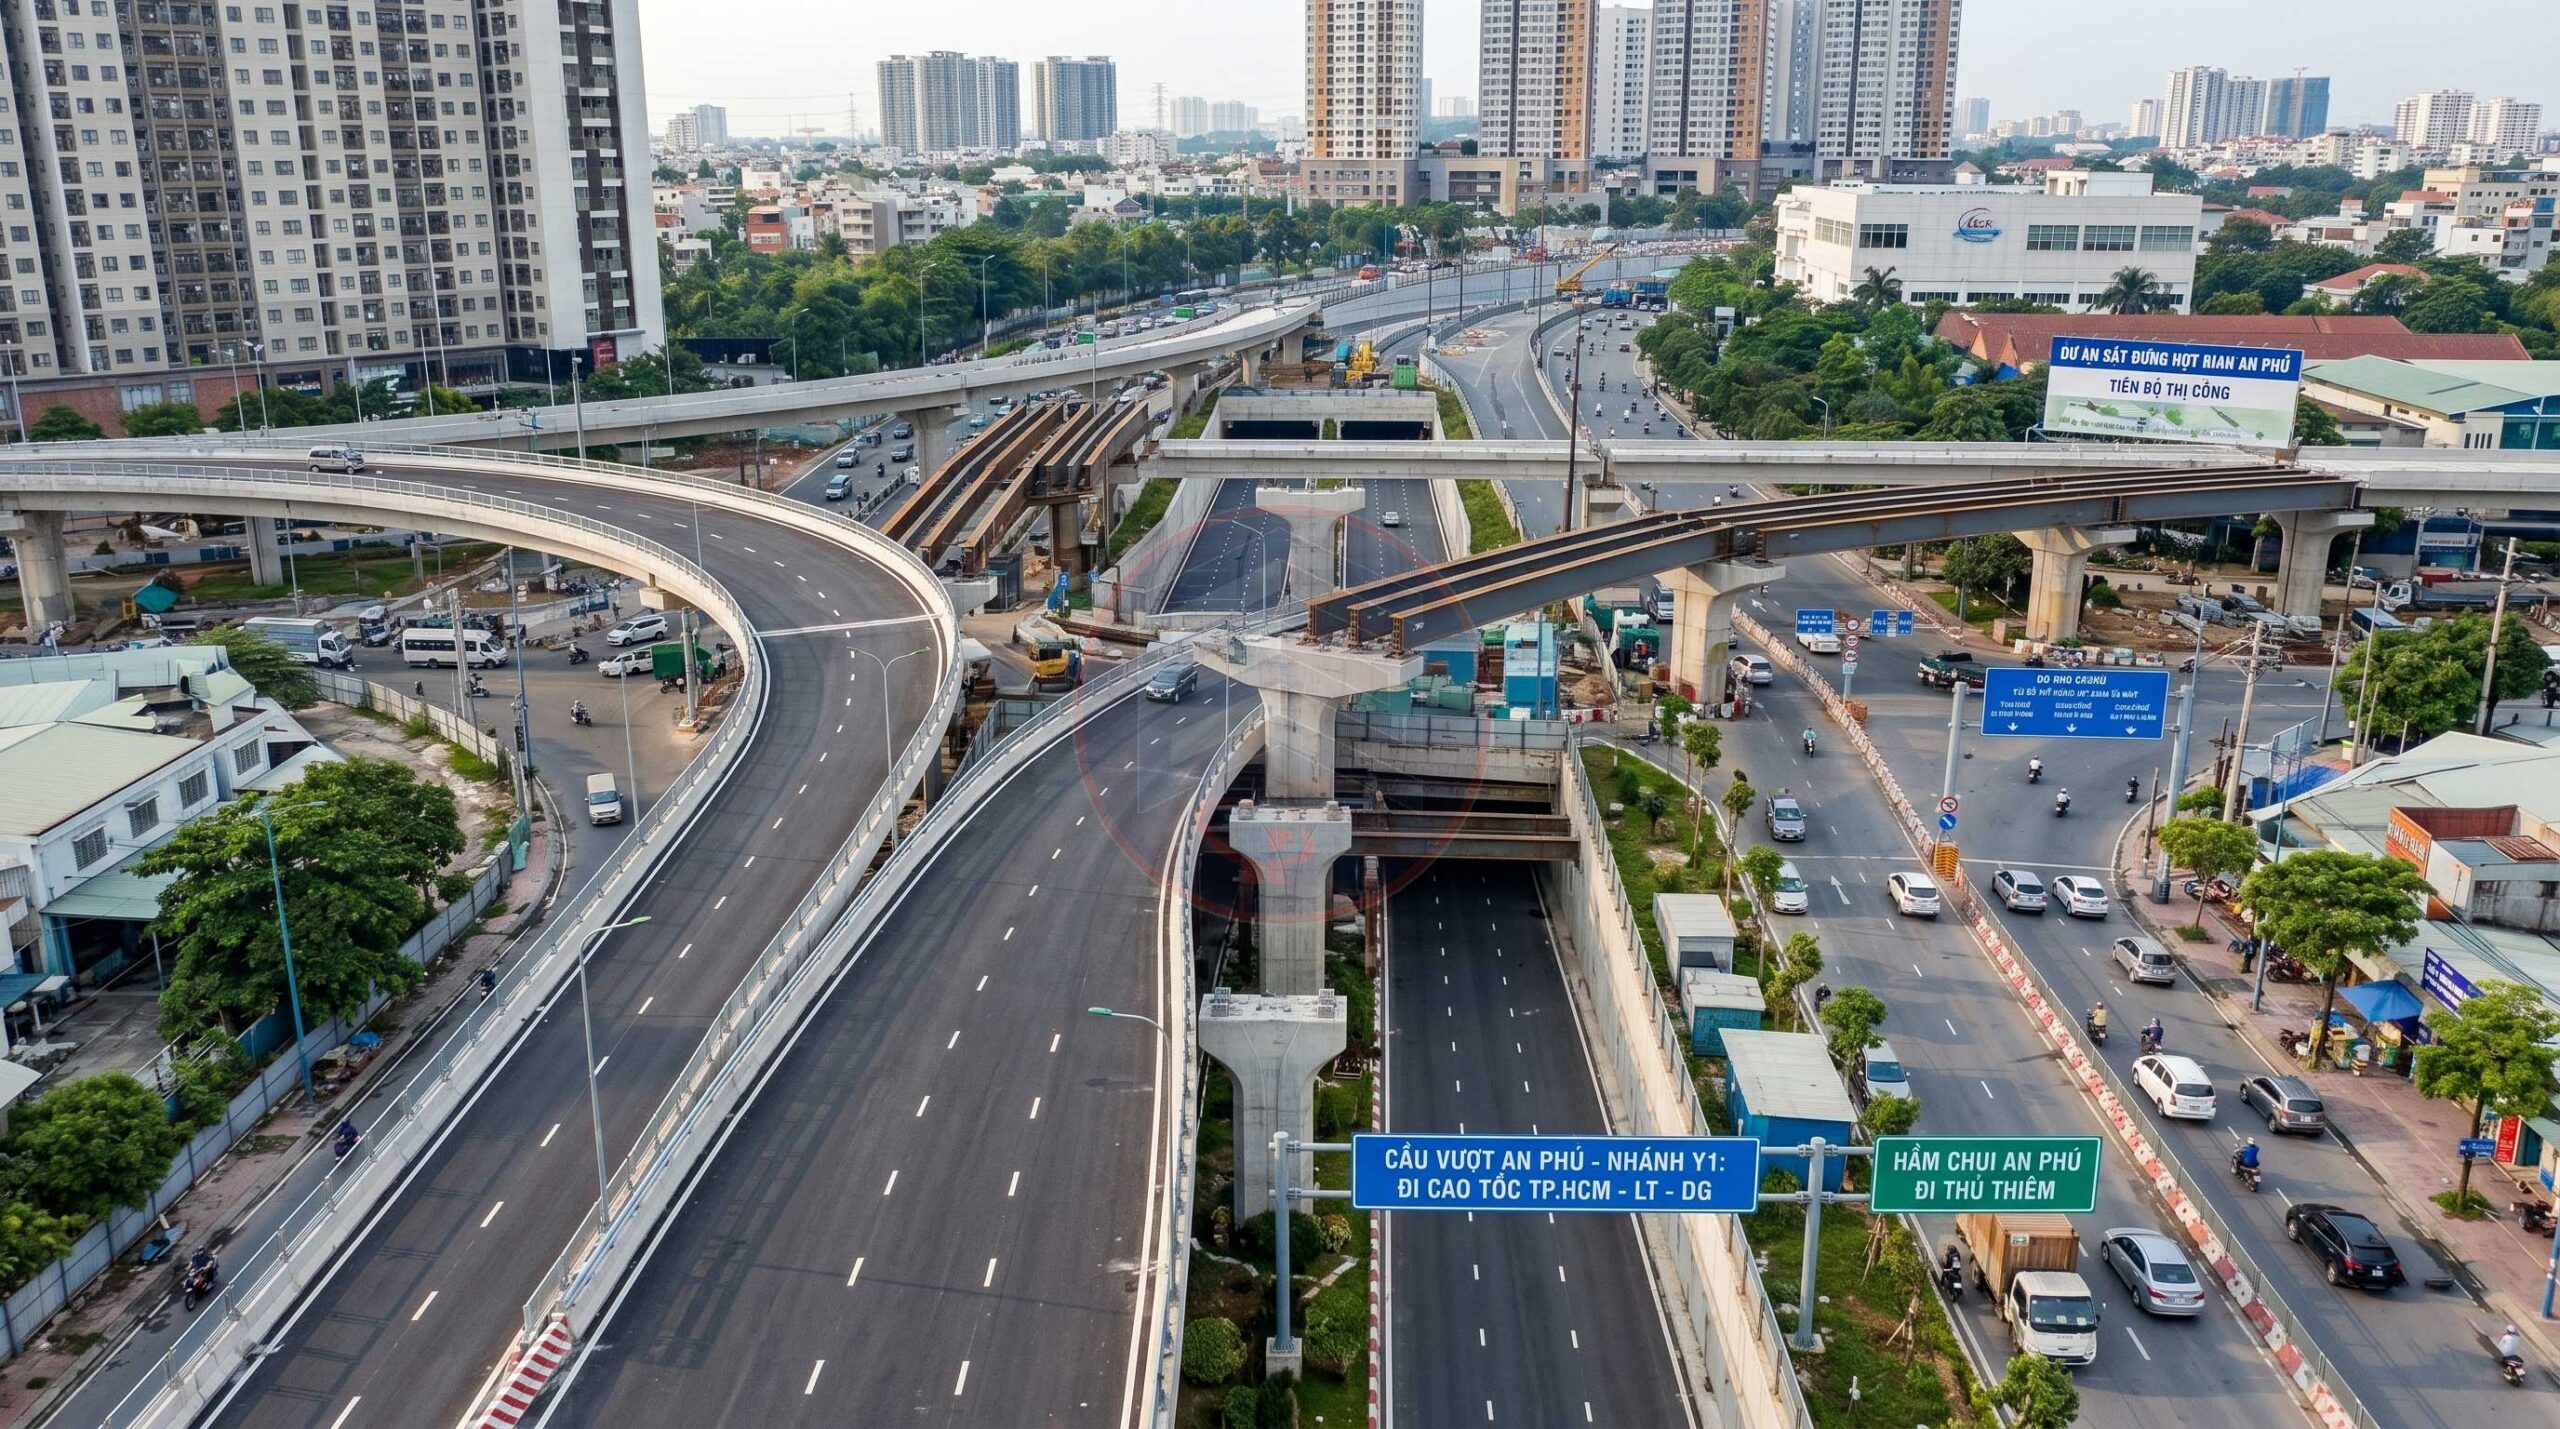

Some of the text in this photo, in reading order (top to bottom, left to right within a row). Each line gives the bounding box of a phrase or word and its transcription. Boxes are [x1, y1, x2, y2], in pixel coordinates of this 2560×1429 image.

[2238, 356, 2258, 372] AN
[1386, 1142, 1428, 1170] CẦU
[1437, 1149, 1495, 1173] VƯỢT
[1502, 1151, 1531, 1170] AN
[1541, 1145, 1584, 1171] PHÚ
[1609, 1147, 1684, 1171] NHÁNH
[1693, 1152, 1725, 1172] Y1:
[1894, 1143, 2082, 1171] HẦM CHUI AN PHÚ
[1398, 1178, 1419, 1198] ĐI
[1428, 1179, 1471, 1199] CAO
[1529, 1180, 1611, 1200] TP.HCM
[1635, 1180, 1659, 1200] LT
[1682, 1181, 1712, 1201] DG
[1914, 1181, 1936, 1200] ĐI
[1992, 1175, 2056, 1200] THIÊM
